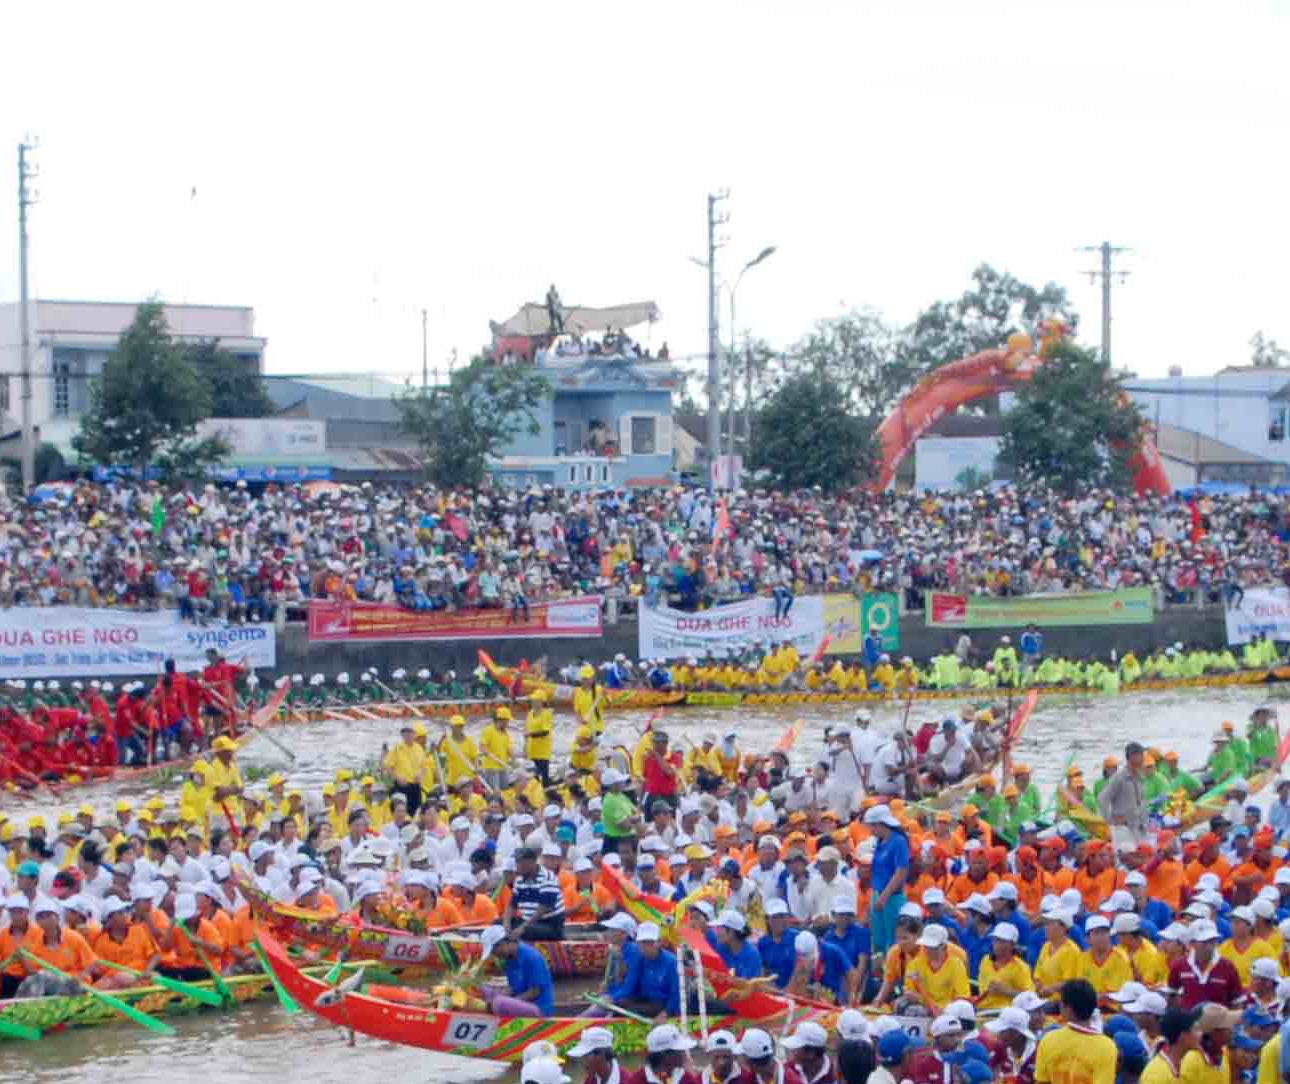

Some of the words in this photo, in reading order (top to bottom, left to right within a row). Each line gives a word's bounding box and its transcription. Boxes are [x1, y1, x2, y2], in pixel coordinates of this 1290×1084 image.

[42, 629, 86, 645] GHE
[93, 627, 139, 644] NGO
[186, 628, 266, 649] syngenta
[394, 943, 422, 958] 06
[454, 1022, 488, 1041] 07
